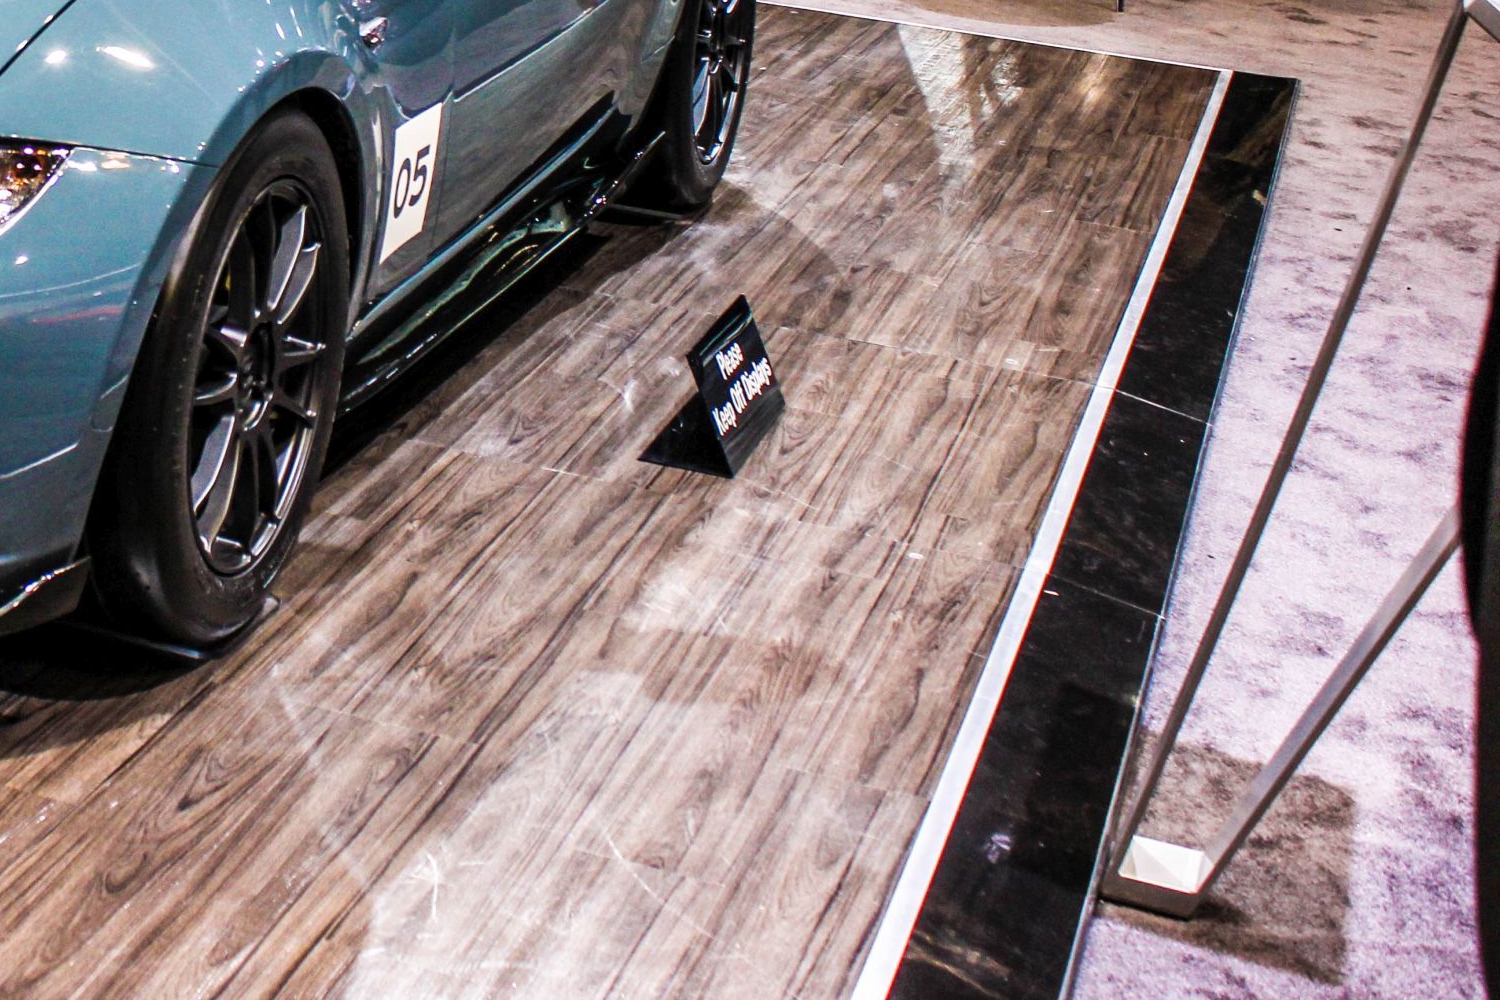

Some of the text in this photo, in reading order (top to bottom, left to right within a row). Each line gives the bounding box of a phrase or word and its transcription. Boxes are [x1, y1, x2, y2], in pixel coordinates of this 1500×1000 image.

[393, 144, 431, 219] 05
[712, 357, 773, 436] Keep Off Displays
[714, 342, 745, 381] Please
